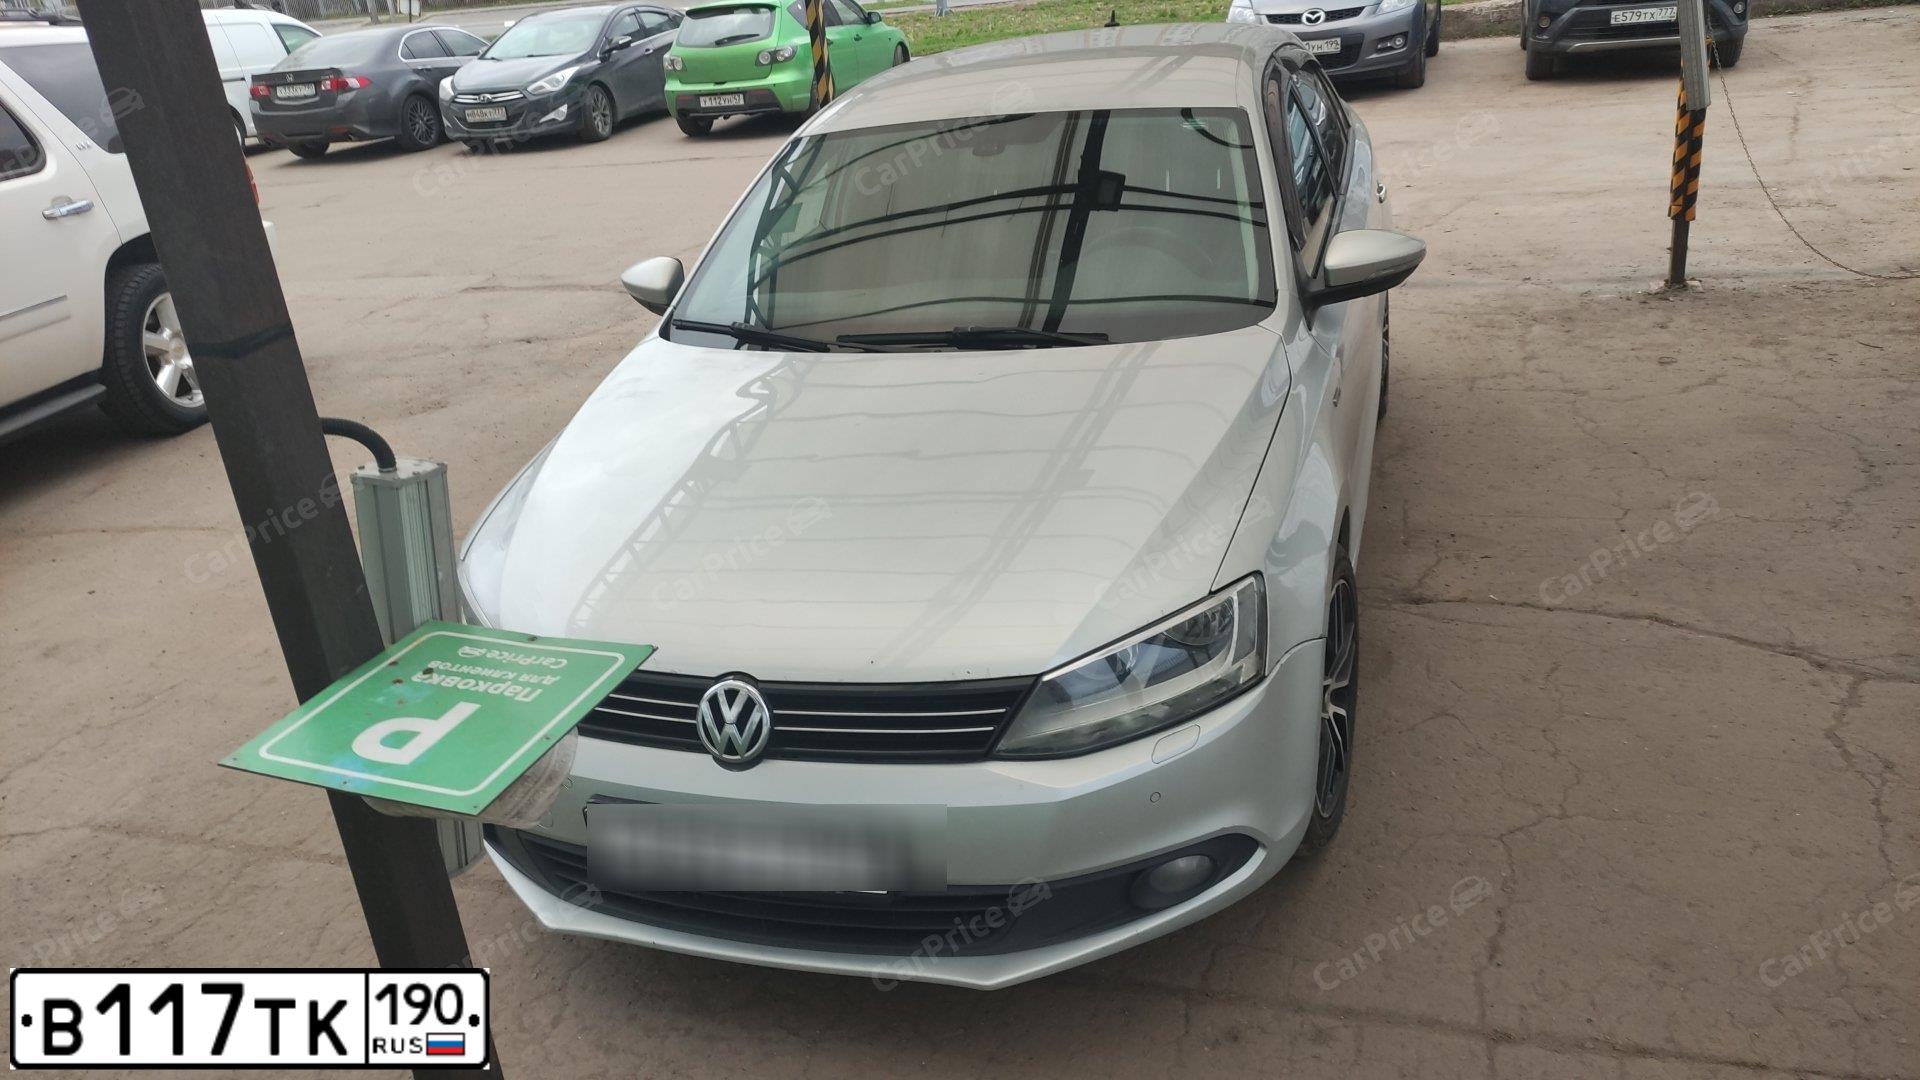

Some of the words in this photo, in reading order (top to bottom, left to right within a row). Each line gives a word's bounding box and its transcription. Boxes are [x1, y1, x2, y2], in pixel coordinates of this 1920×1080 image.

[484, 648, 568, 669] CarPrice
[411, 671, 543, 702] Парковка
[352, 701, 481, 765] P
